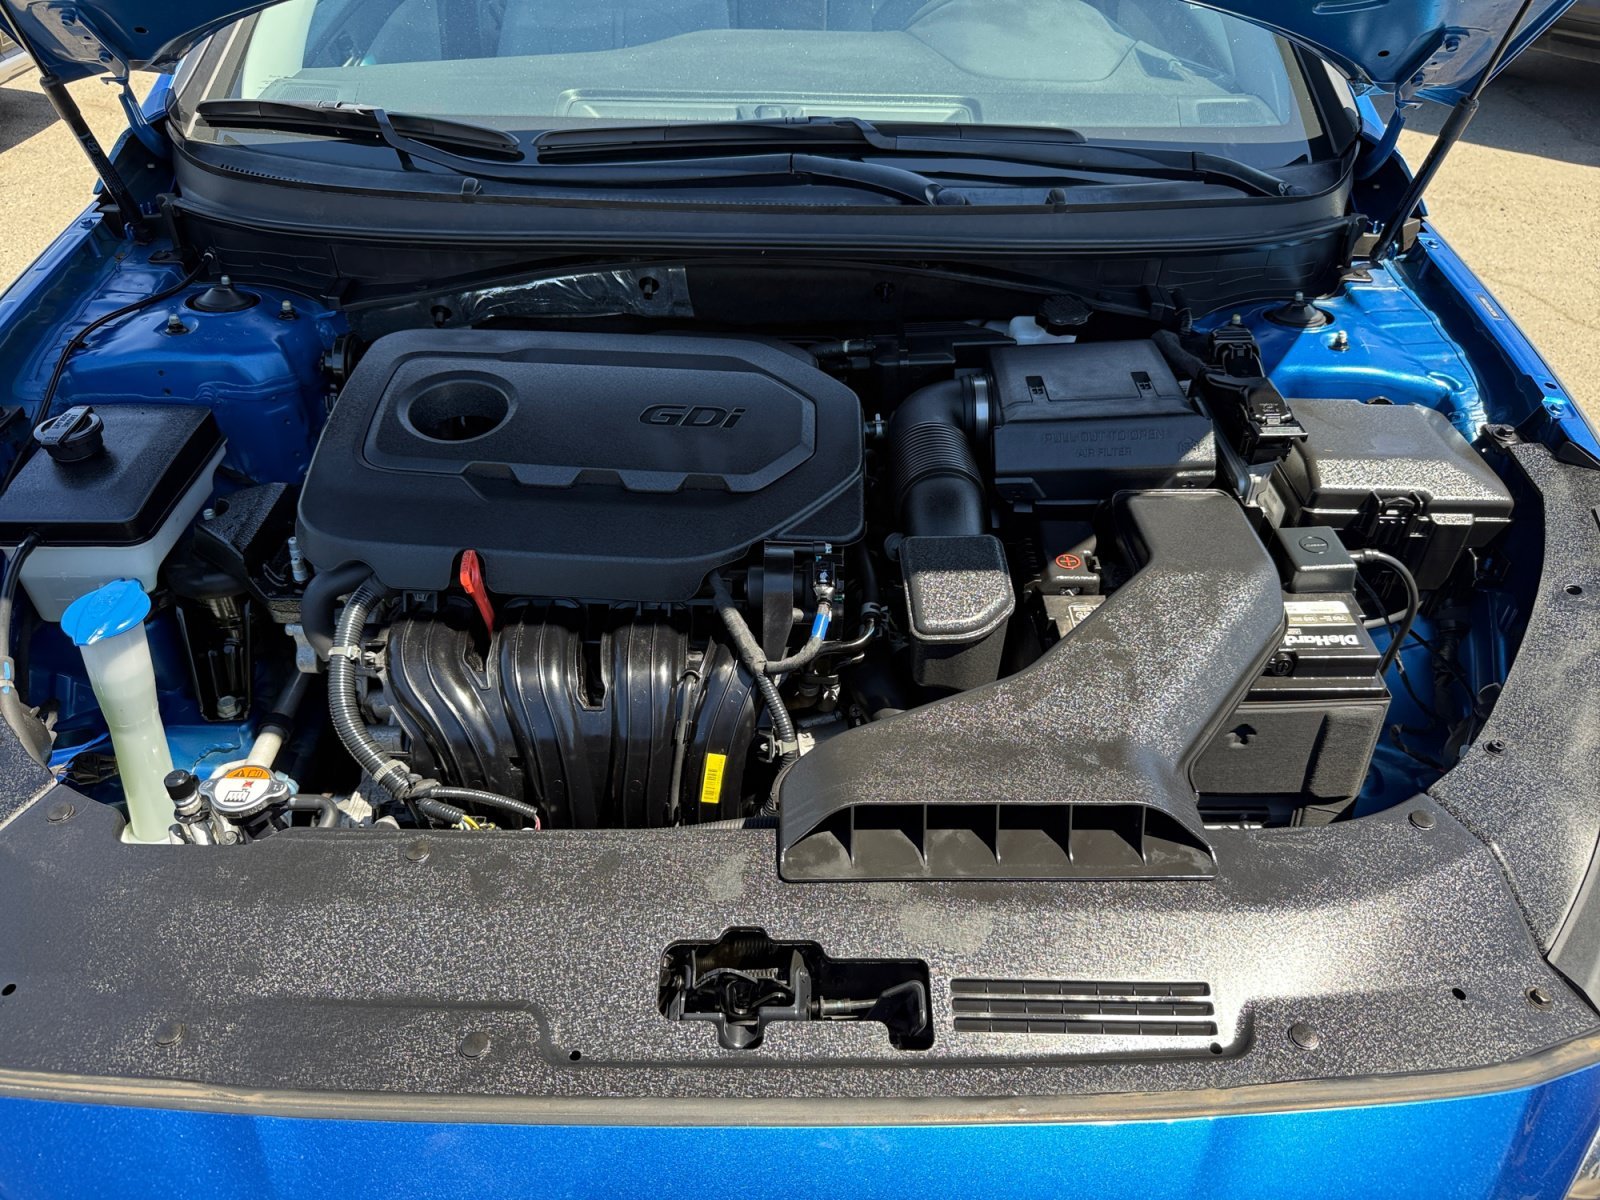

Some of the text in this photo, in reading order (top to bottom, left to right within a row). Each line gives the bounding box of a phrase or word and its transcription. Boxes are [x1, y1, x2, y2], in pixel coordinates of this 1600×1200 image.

[639, 403, 746, 429] GDi
[1043, 429, 1166, 444] PULL OUT TO OPEN
[1076, 447, 1133, 458] AIR FILTER
[1283, 634, 1359, 646] DieHard
